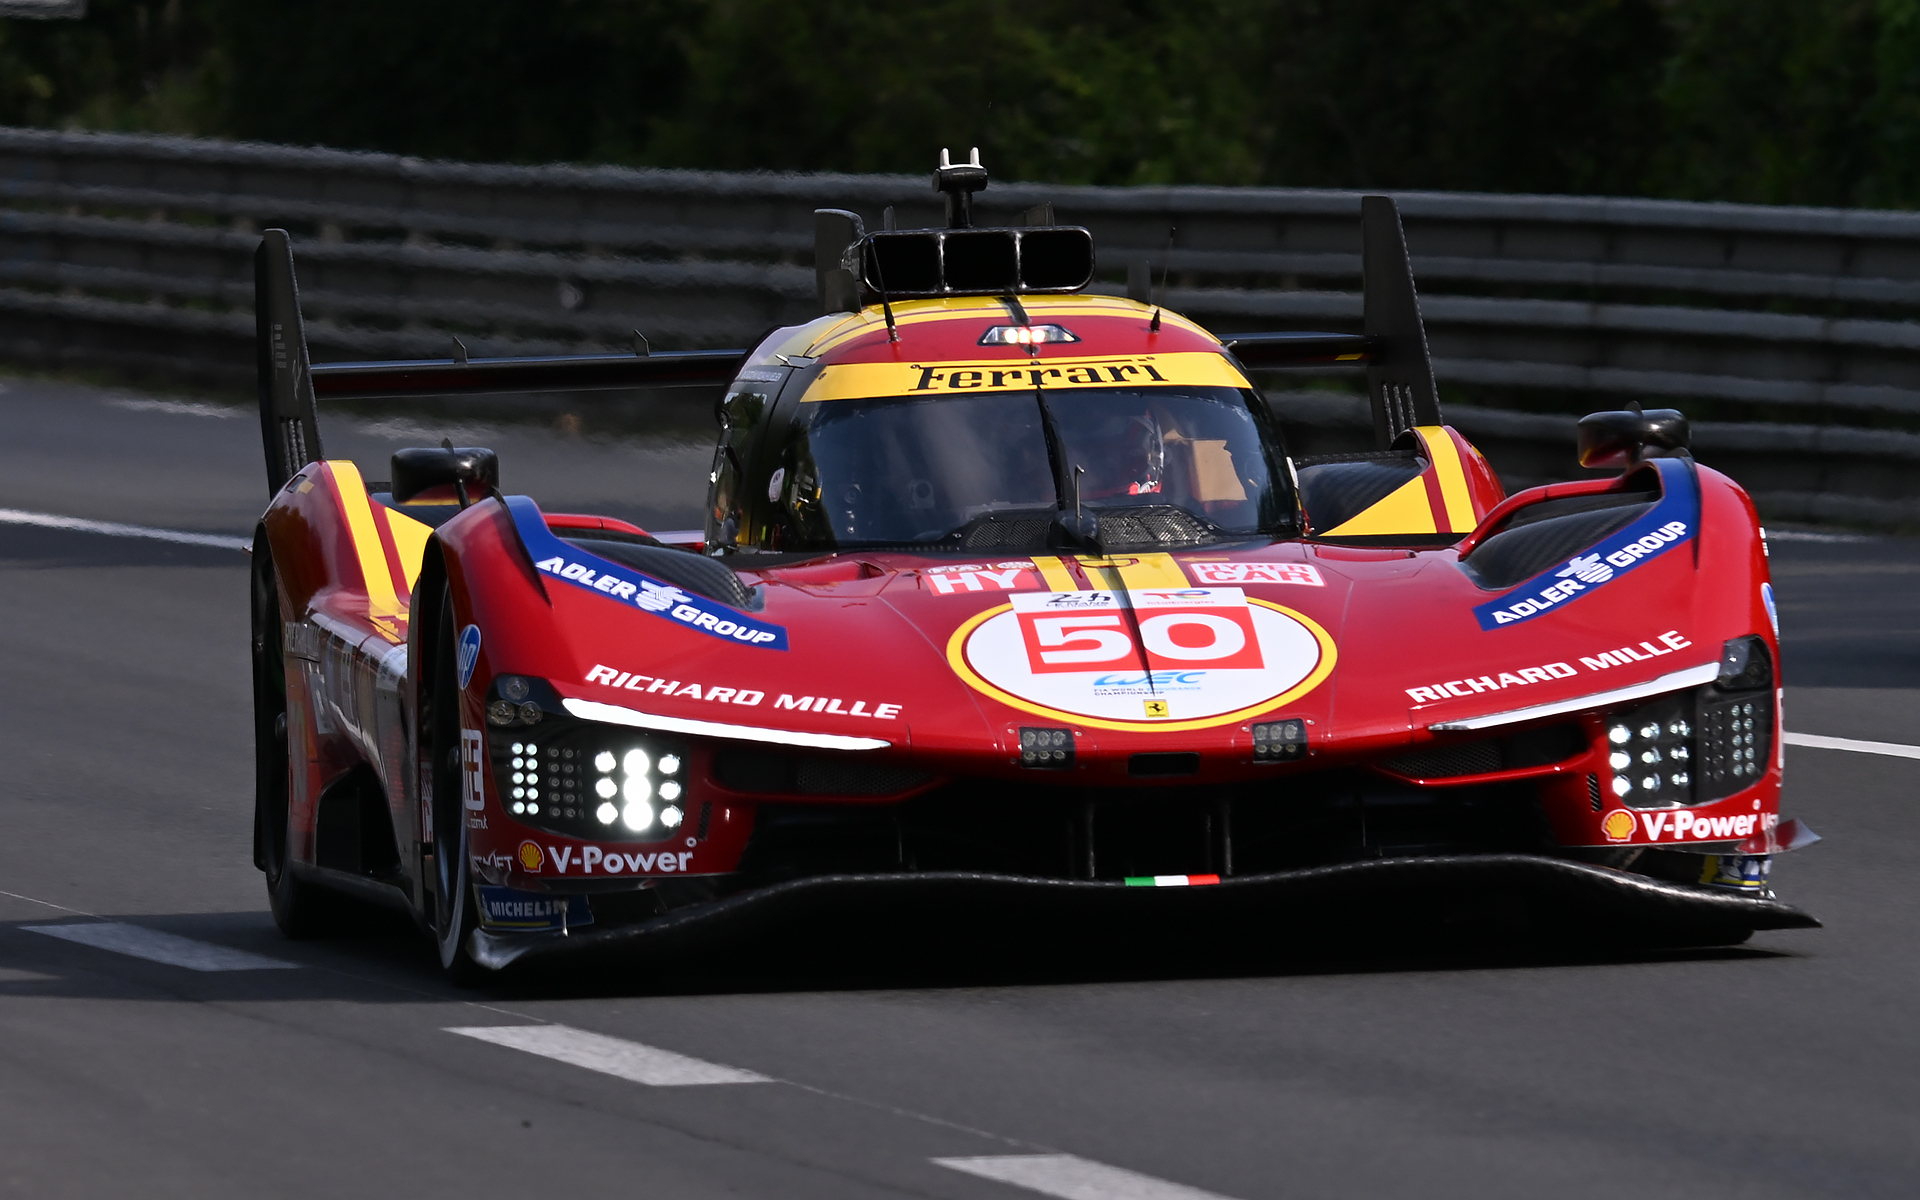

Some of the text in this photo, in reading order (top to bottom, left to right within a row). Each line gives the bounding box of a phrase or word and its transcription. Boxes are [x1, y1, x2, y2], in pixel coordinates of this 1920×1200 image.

[908, 356, 1169, 391] Ferrari
[930, 569, 1022, 594] HY
[1199, 564, 1309, 572] HYPER
[1204, 570, 1315, 583] CAR
[1492, 521, 1687, 625] ADLER GROUP
[535, 556, 776, 645] ADLER GROUP
[1032, 612, 1246, 664] 50
[1093, 671, 1207, 686] WEC
[1405, 630, 1692, 703] RICHARD MILLE
[585, 664, 903, 720] RICHARD MILLE
[1641, 810, 1758, 841] V-Power
[548, 846, 694, 874] V-Power
